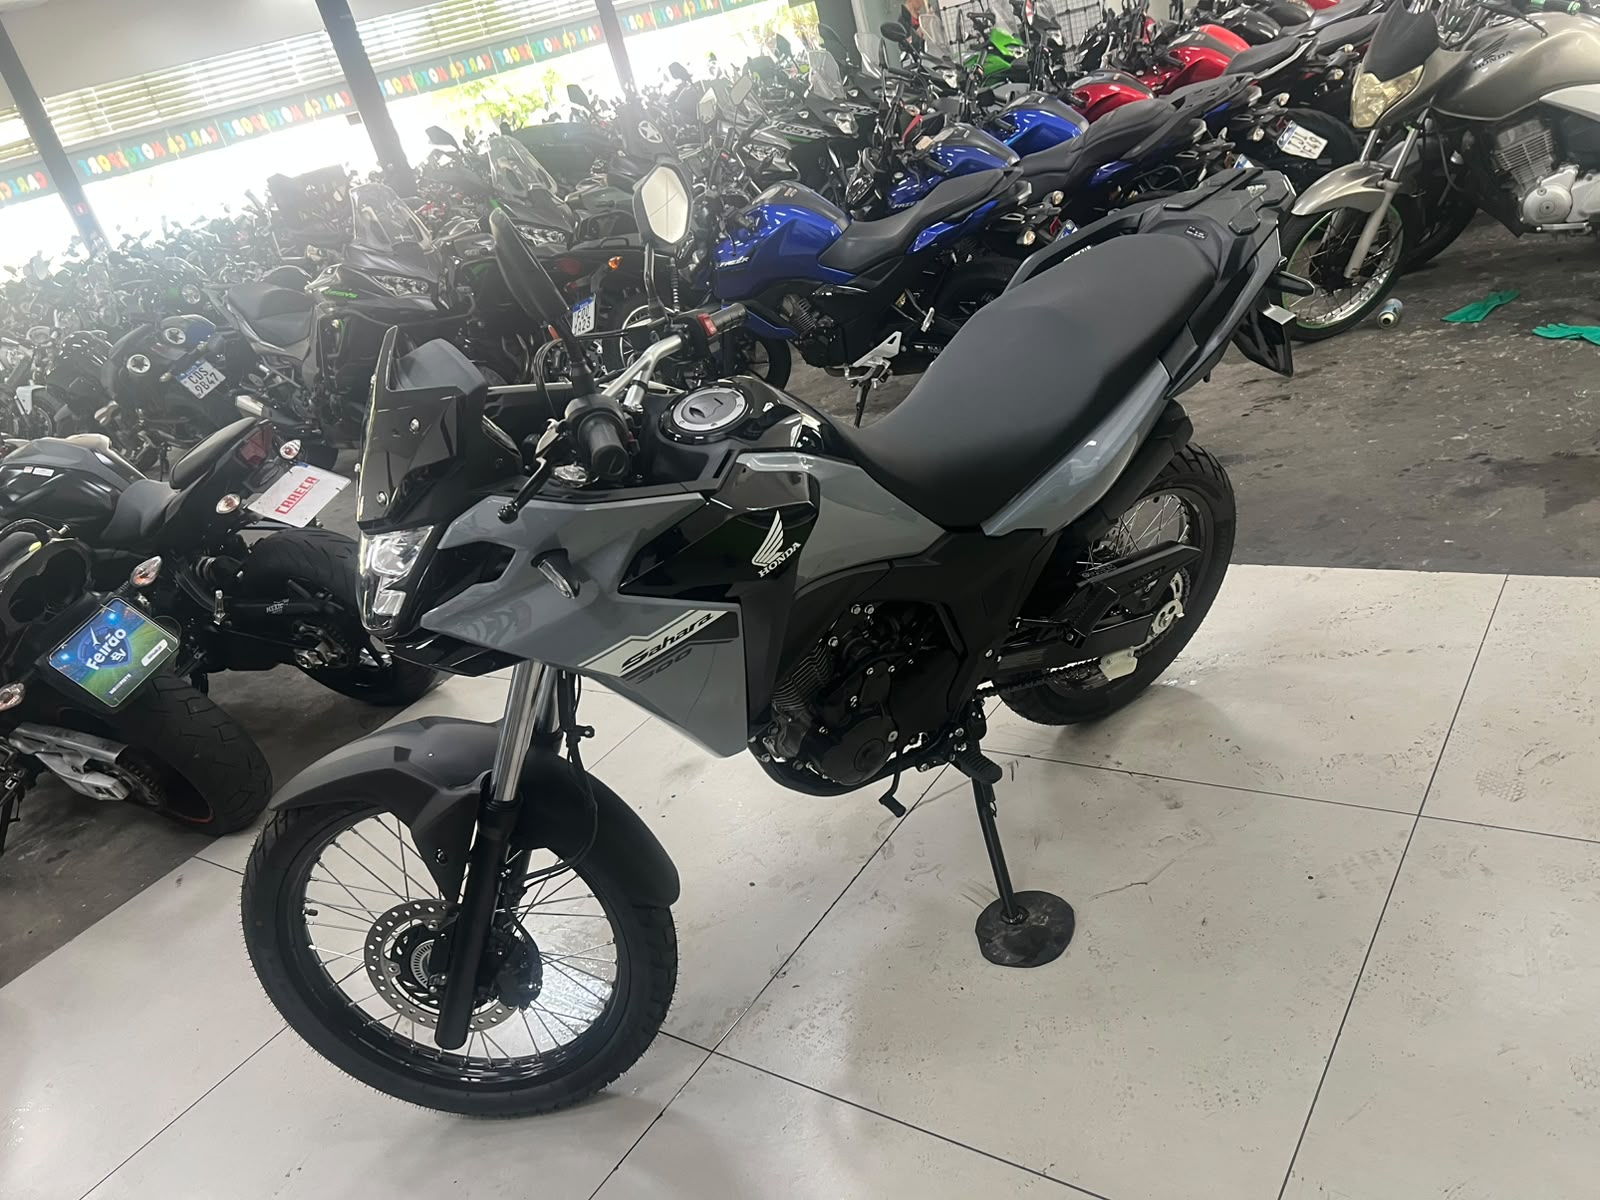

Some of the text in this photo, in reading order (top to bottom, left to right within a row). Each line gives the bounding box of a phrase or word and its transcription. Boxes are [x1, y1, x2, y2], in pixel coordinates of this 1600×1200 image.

[1473, 50, 1514, 70] HONDA
[758, 542, 801, 578] HONDA
[86, 628, 127, 671] Feirão
[620, 612, 714, 674] Sahara
